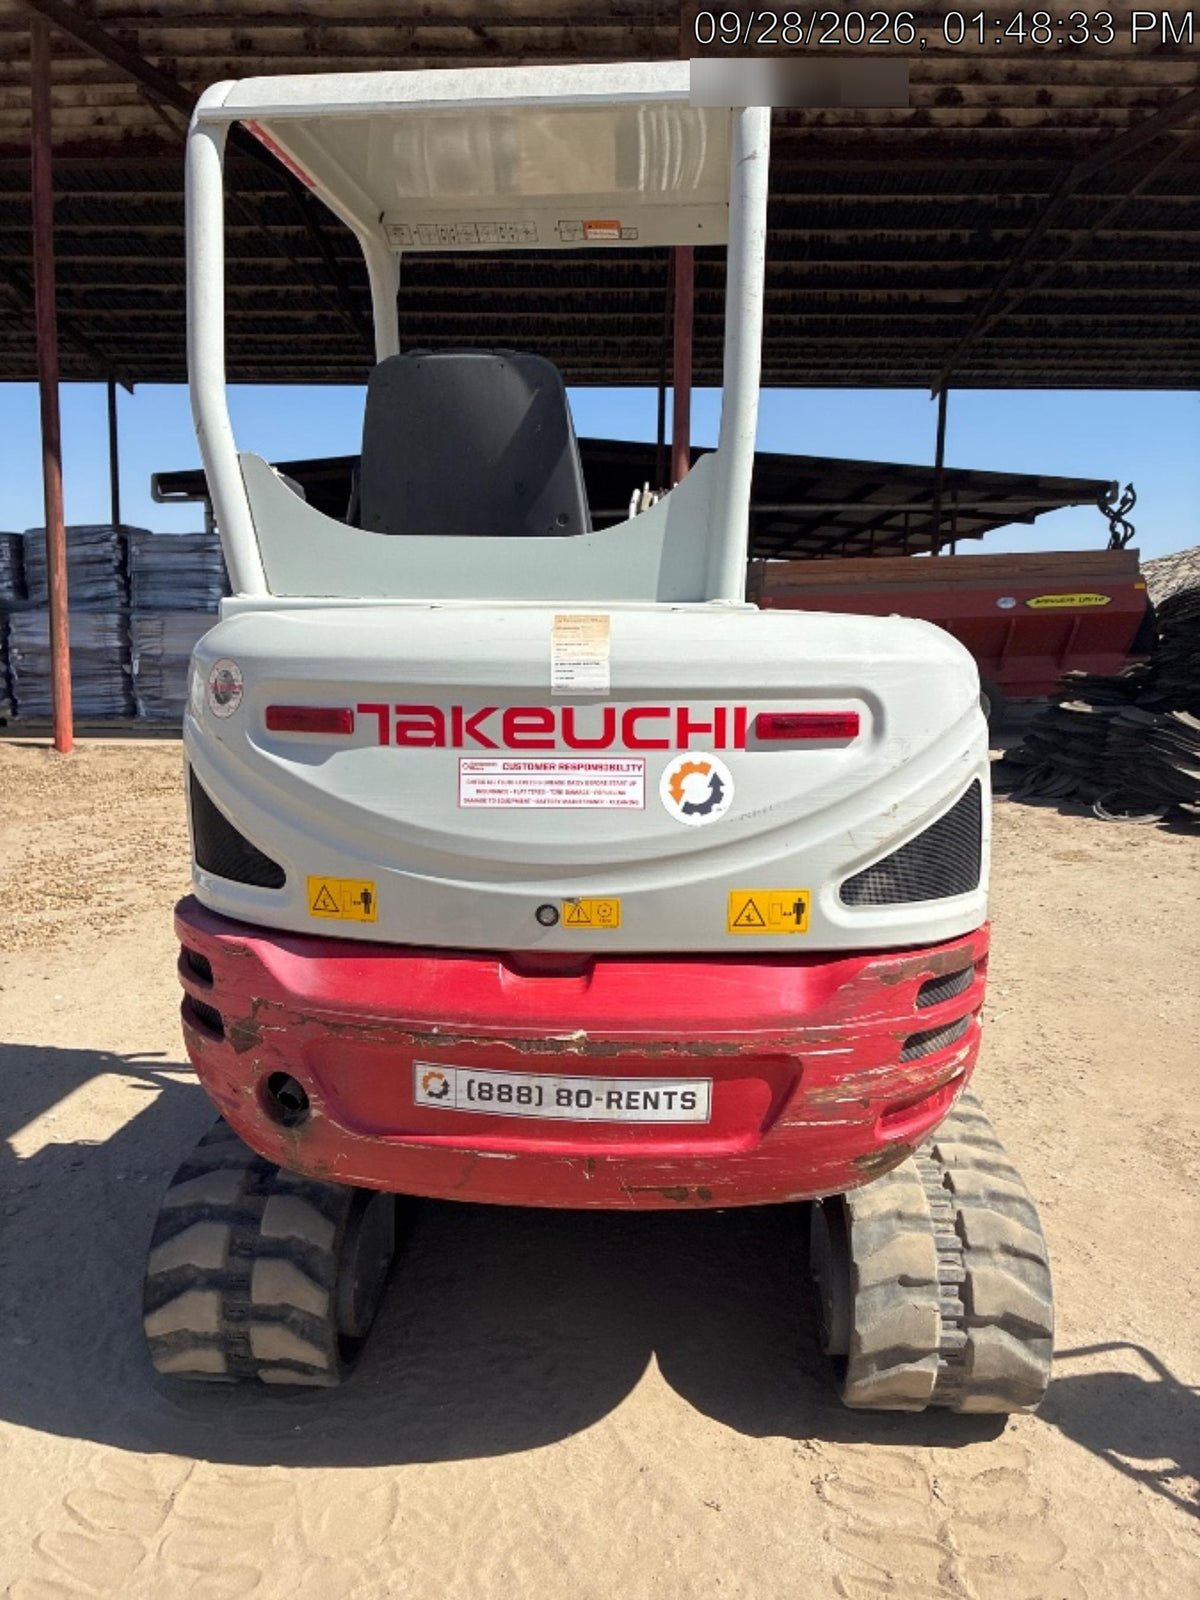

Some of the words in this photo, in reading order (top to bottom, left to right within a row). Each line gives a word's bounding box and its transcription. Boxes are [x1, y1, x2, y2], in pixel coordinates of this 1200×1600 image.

[502, 762, 556, 771] CUSTOMER
[558, 762, 643, 772] RESPONSIBILITY
[466, 1078, 543, 1107] (888)
[556, 1088, 697, 1110] 80-RENTS
